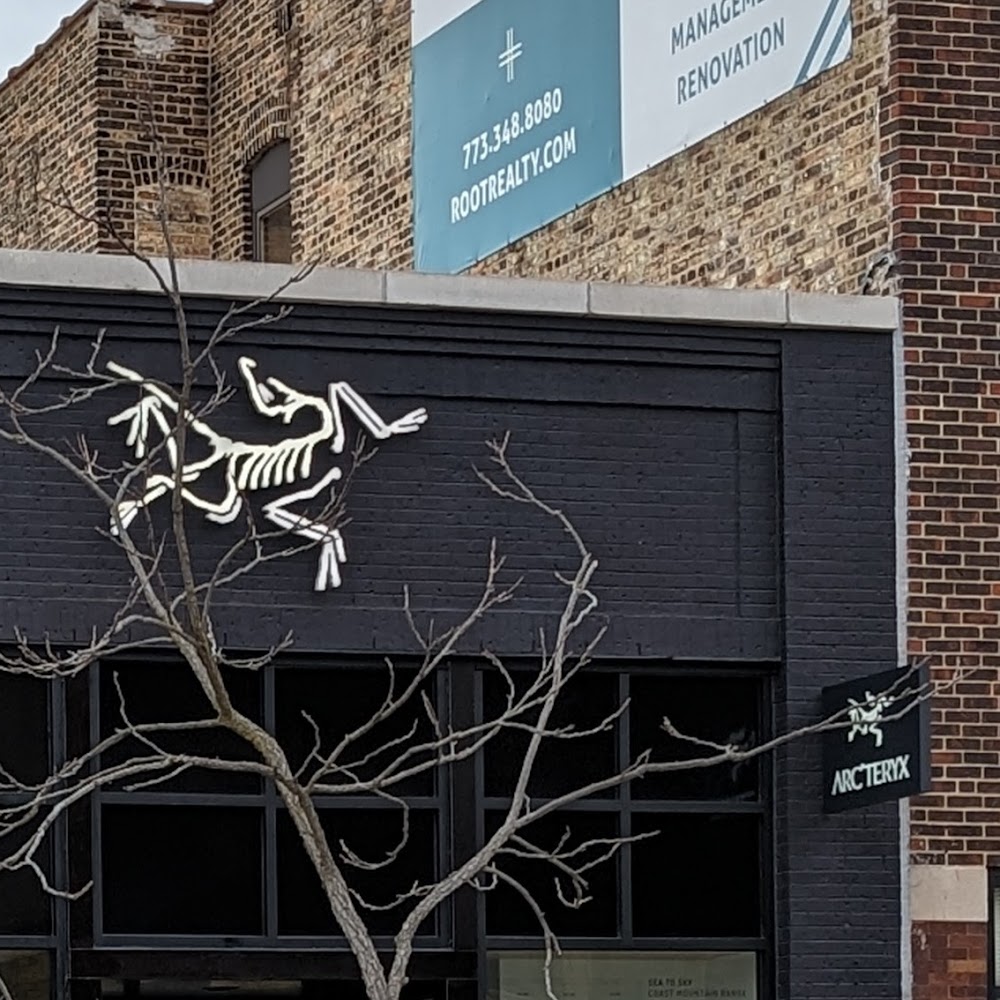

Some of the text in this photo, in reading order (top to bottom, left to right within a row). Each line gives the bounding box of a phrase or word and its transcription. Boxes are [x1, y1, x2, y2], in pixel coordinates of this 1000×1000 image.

[671, 0, 765, 55] MANAGE
[677, 17, 784, 105] RENOVATION
[462, 87, 562, 170] 773.348.8080
[450, 126, 577, 224] ROOTREALTY.COM
